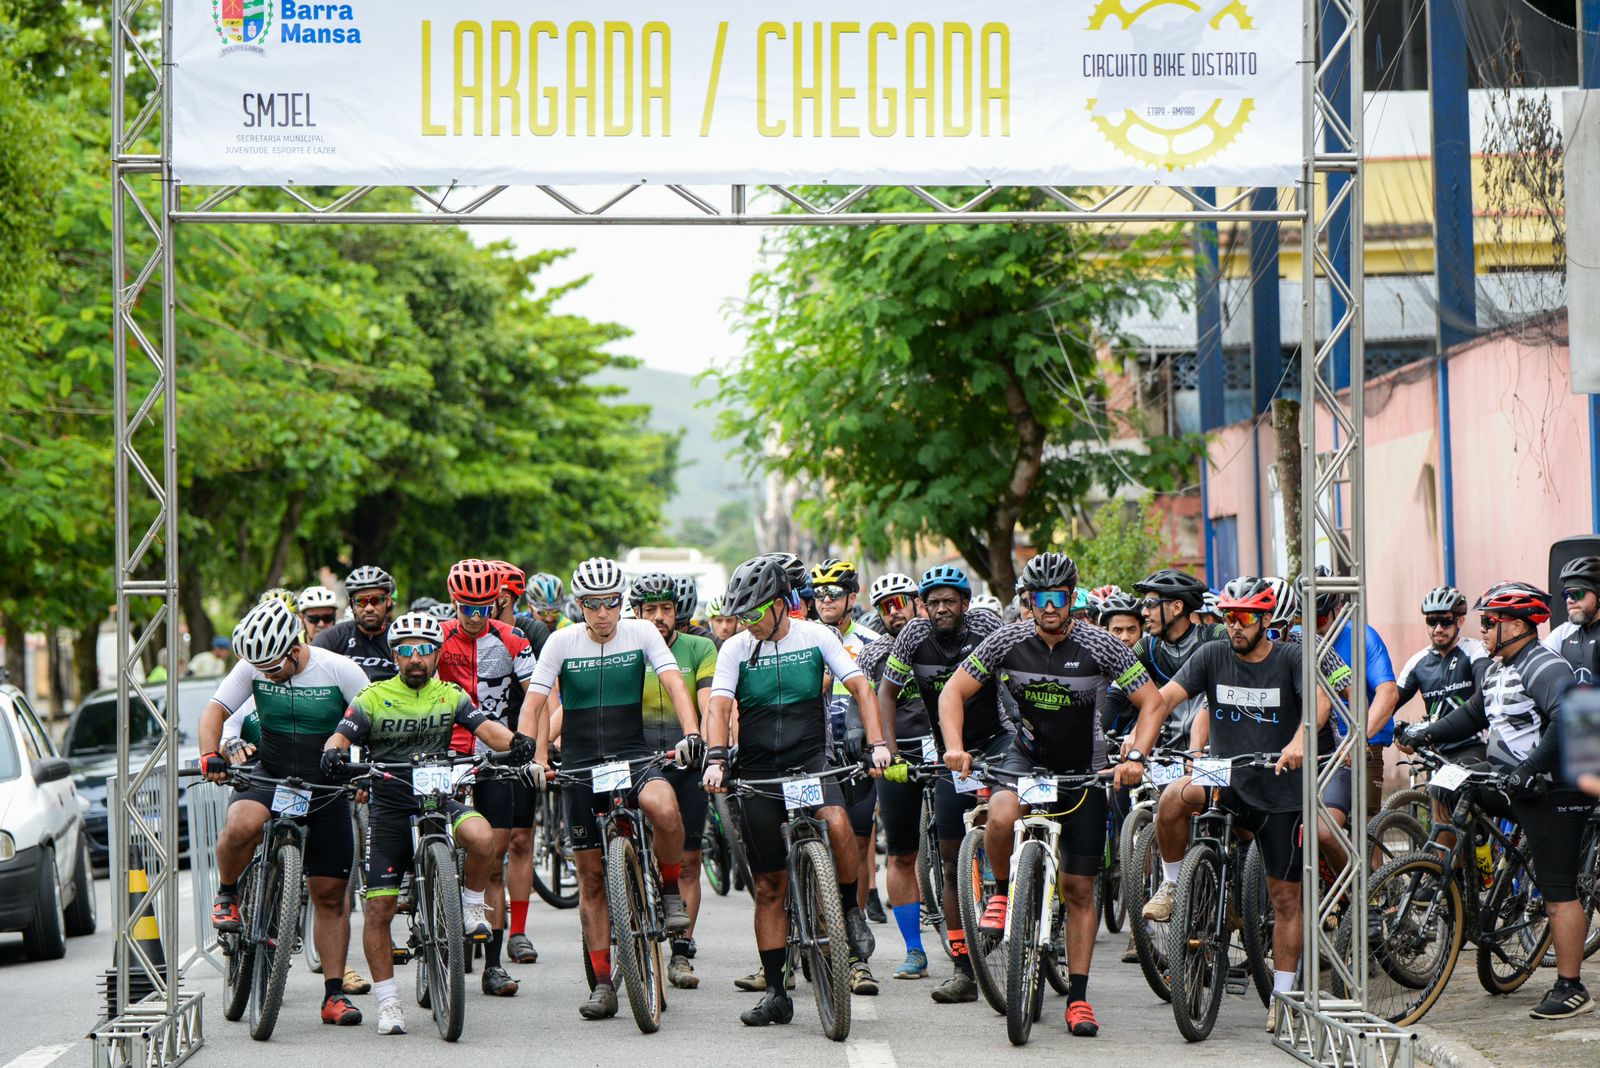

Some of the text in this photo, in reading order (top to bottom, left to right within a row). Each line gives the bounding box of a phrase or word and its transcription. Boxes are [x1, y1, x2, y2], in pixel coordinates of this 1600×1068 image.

[281, 0, 353, 20] Barra
[281, 23, 361, 43] Mansa
[1083, 52, 1257, 77] CIRCUITO BIKE DISTRITO
[421, 20, 671, 137] LARGADA
[756, 21, 1010, 137] CHEGADA
[243, 93, 316, 127] SMJEL
[1147, 106, 1166, 116] ETAPA
[1172, 106, 1196, 116] AMPARO
[236, 134, 325, 143] SECRETARIA MUNICIPAL
[273, 146, 305, 154] ESPORTE
[307, 146, 311, 154] E
[313, 146, 336, 154] LAZER
[567, 653, 637, 669] ELITEGROUP
[1024, 690, 1071, 704] PAULISTA
[1227, 689, 1268, 702] RIP
[1215, 708, 1279, 723] CURL
[1166, 763, 1182, 779] 525
[431, 772, 449, 789] 576
